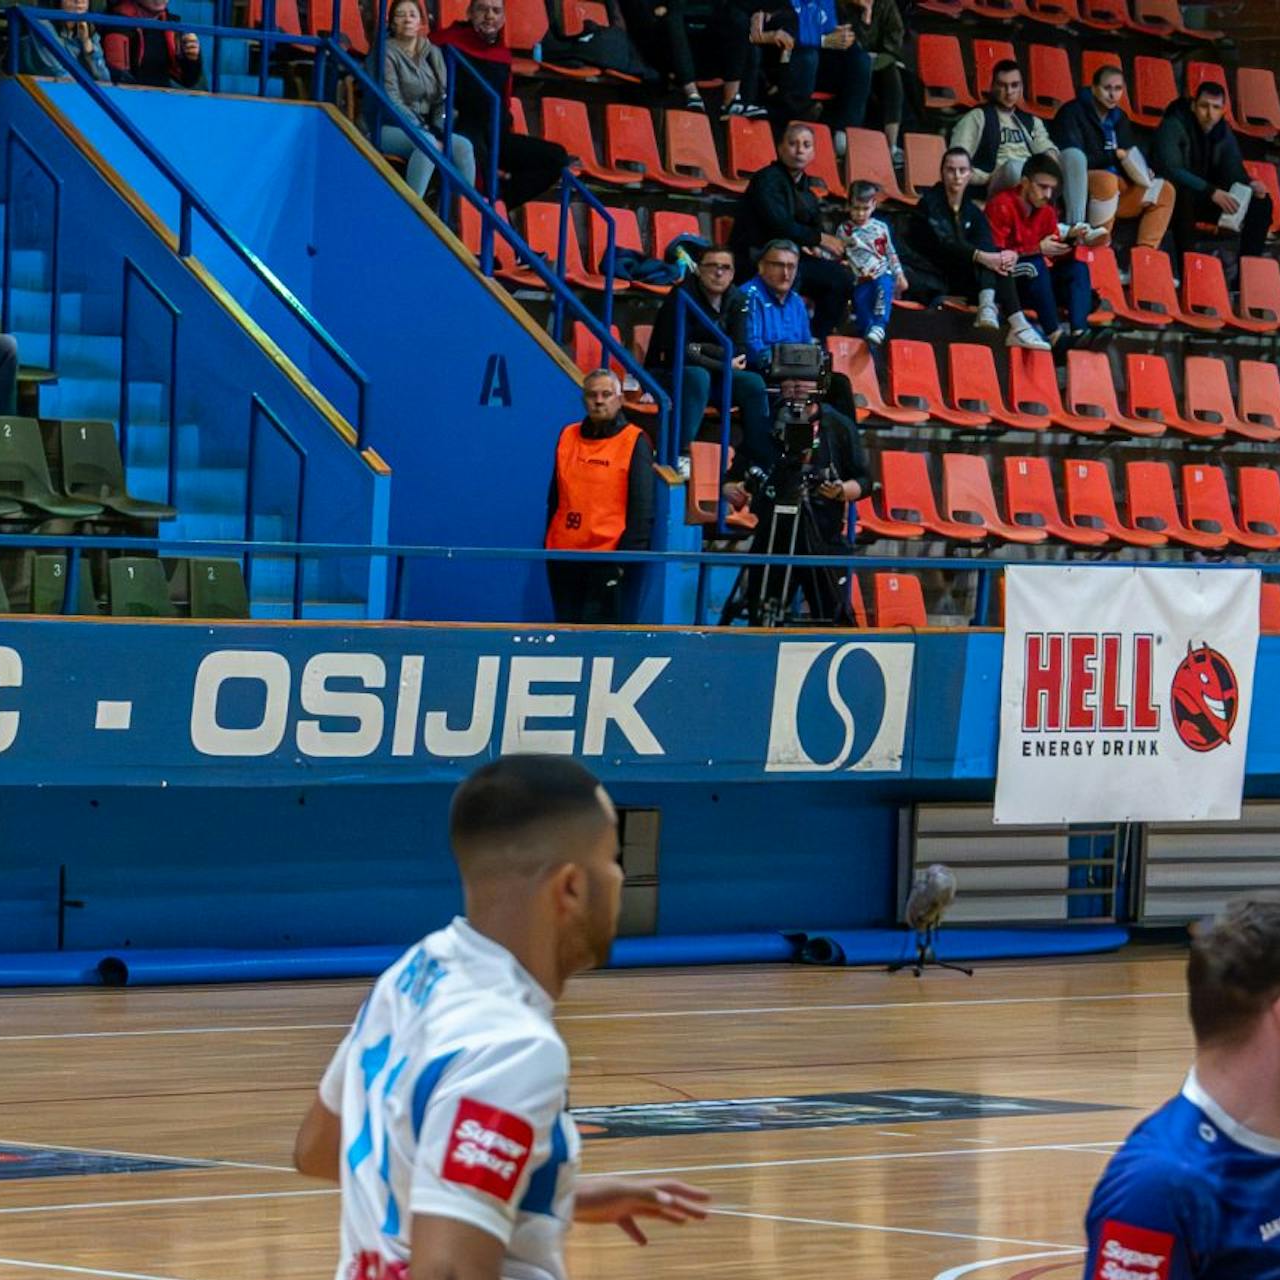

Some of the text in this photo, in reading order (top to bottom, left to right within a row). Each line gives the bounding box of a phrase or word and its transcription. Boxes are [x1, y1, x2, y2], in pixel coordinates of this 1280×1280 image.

[479, 353, 513, 408] A
[53, 563, 62, 577] 3
[190, 650, 671, 757] OSIJEK
[1021, 632, 1161, 732] HELL
[1022, 739, 1160, 757] ENERGY DRINK
[451, 1140, 518, 1180] Sport
